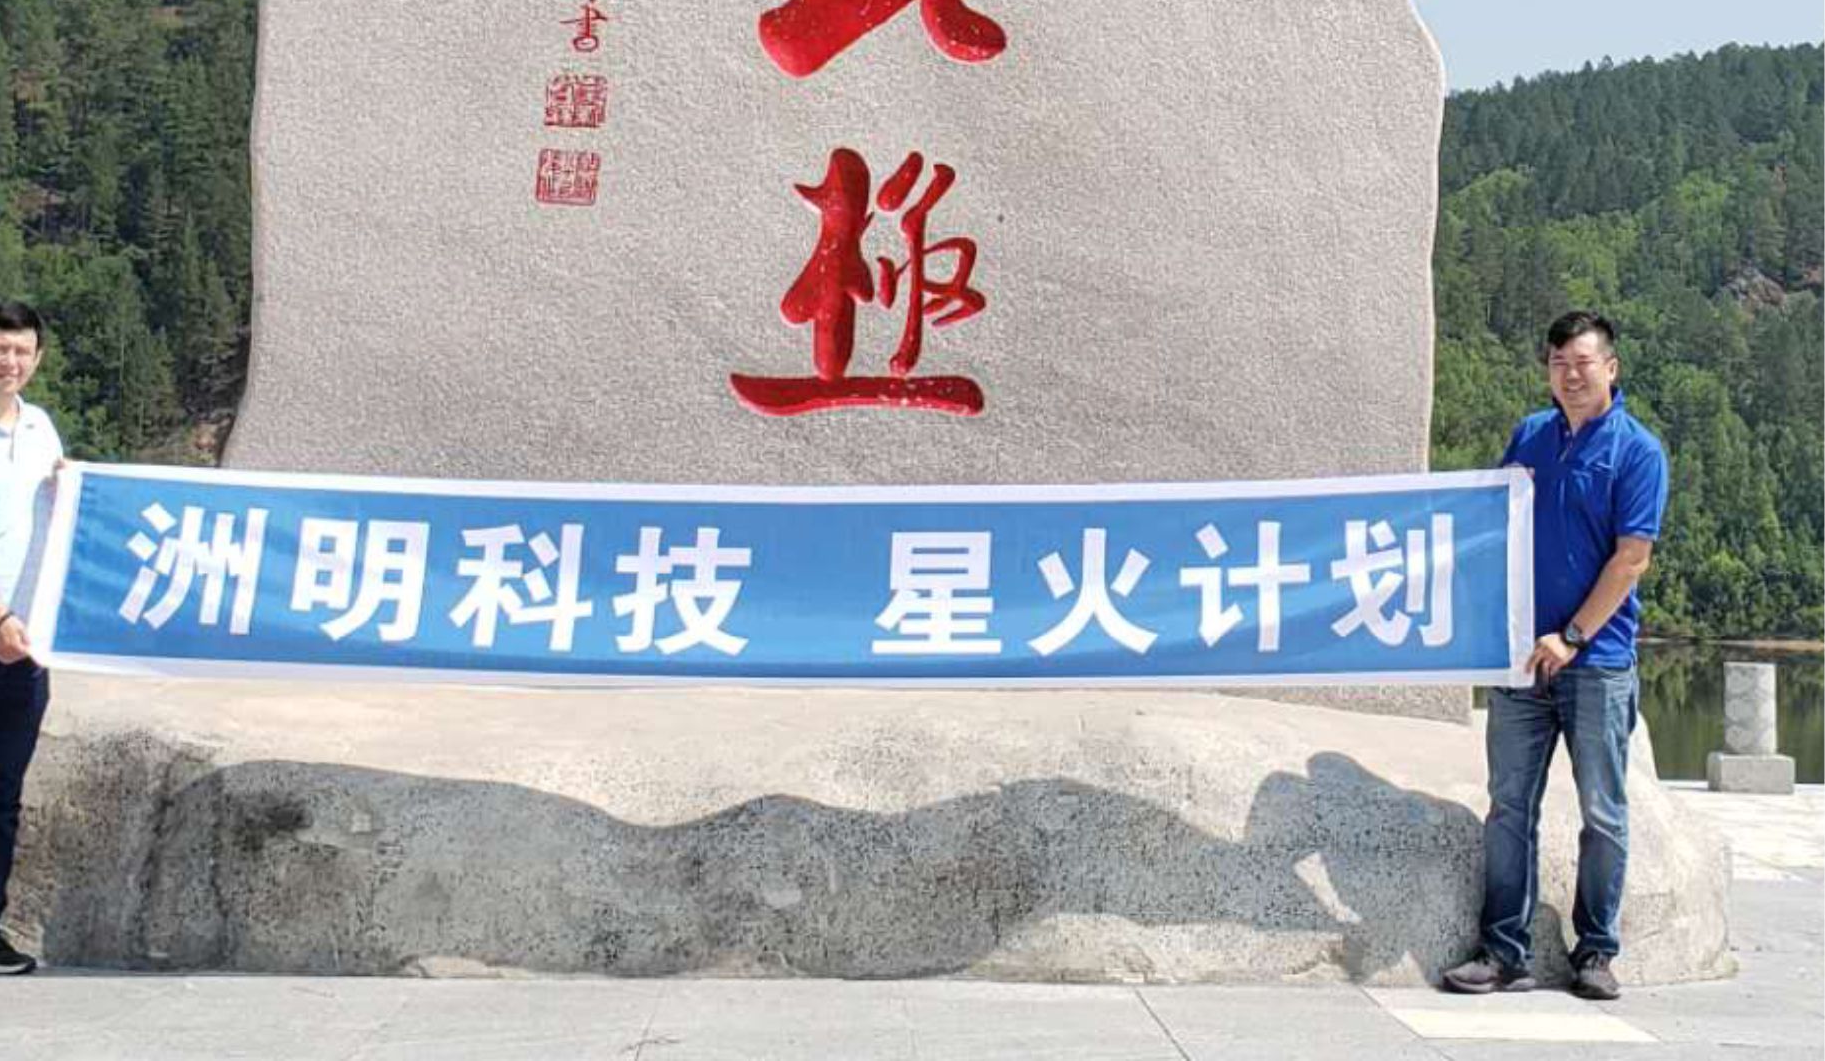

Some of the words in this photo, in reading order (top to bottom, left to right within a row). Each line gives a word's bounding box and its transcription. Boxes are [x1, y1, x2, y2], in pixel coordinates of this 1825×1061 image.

[118, 500, 752, 660] 洲明科技
[870, 513, 1456, 658] 星火计划
